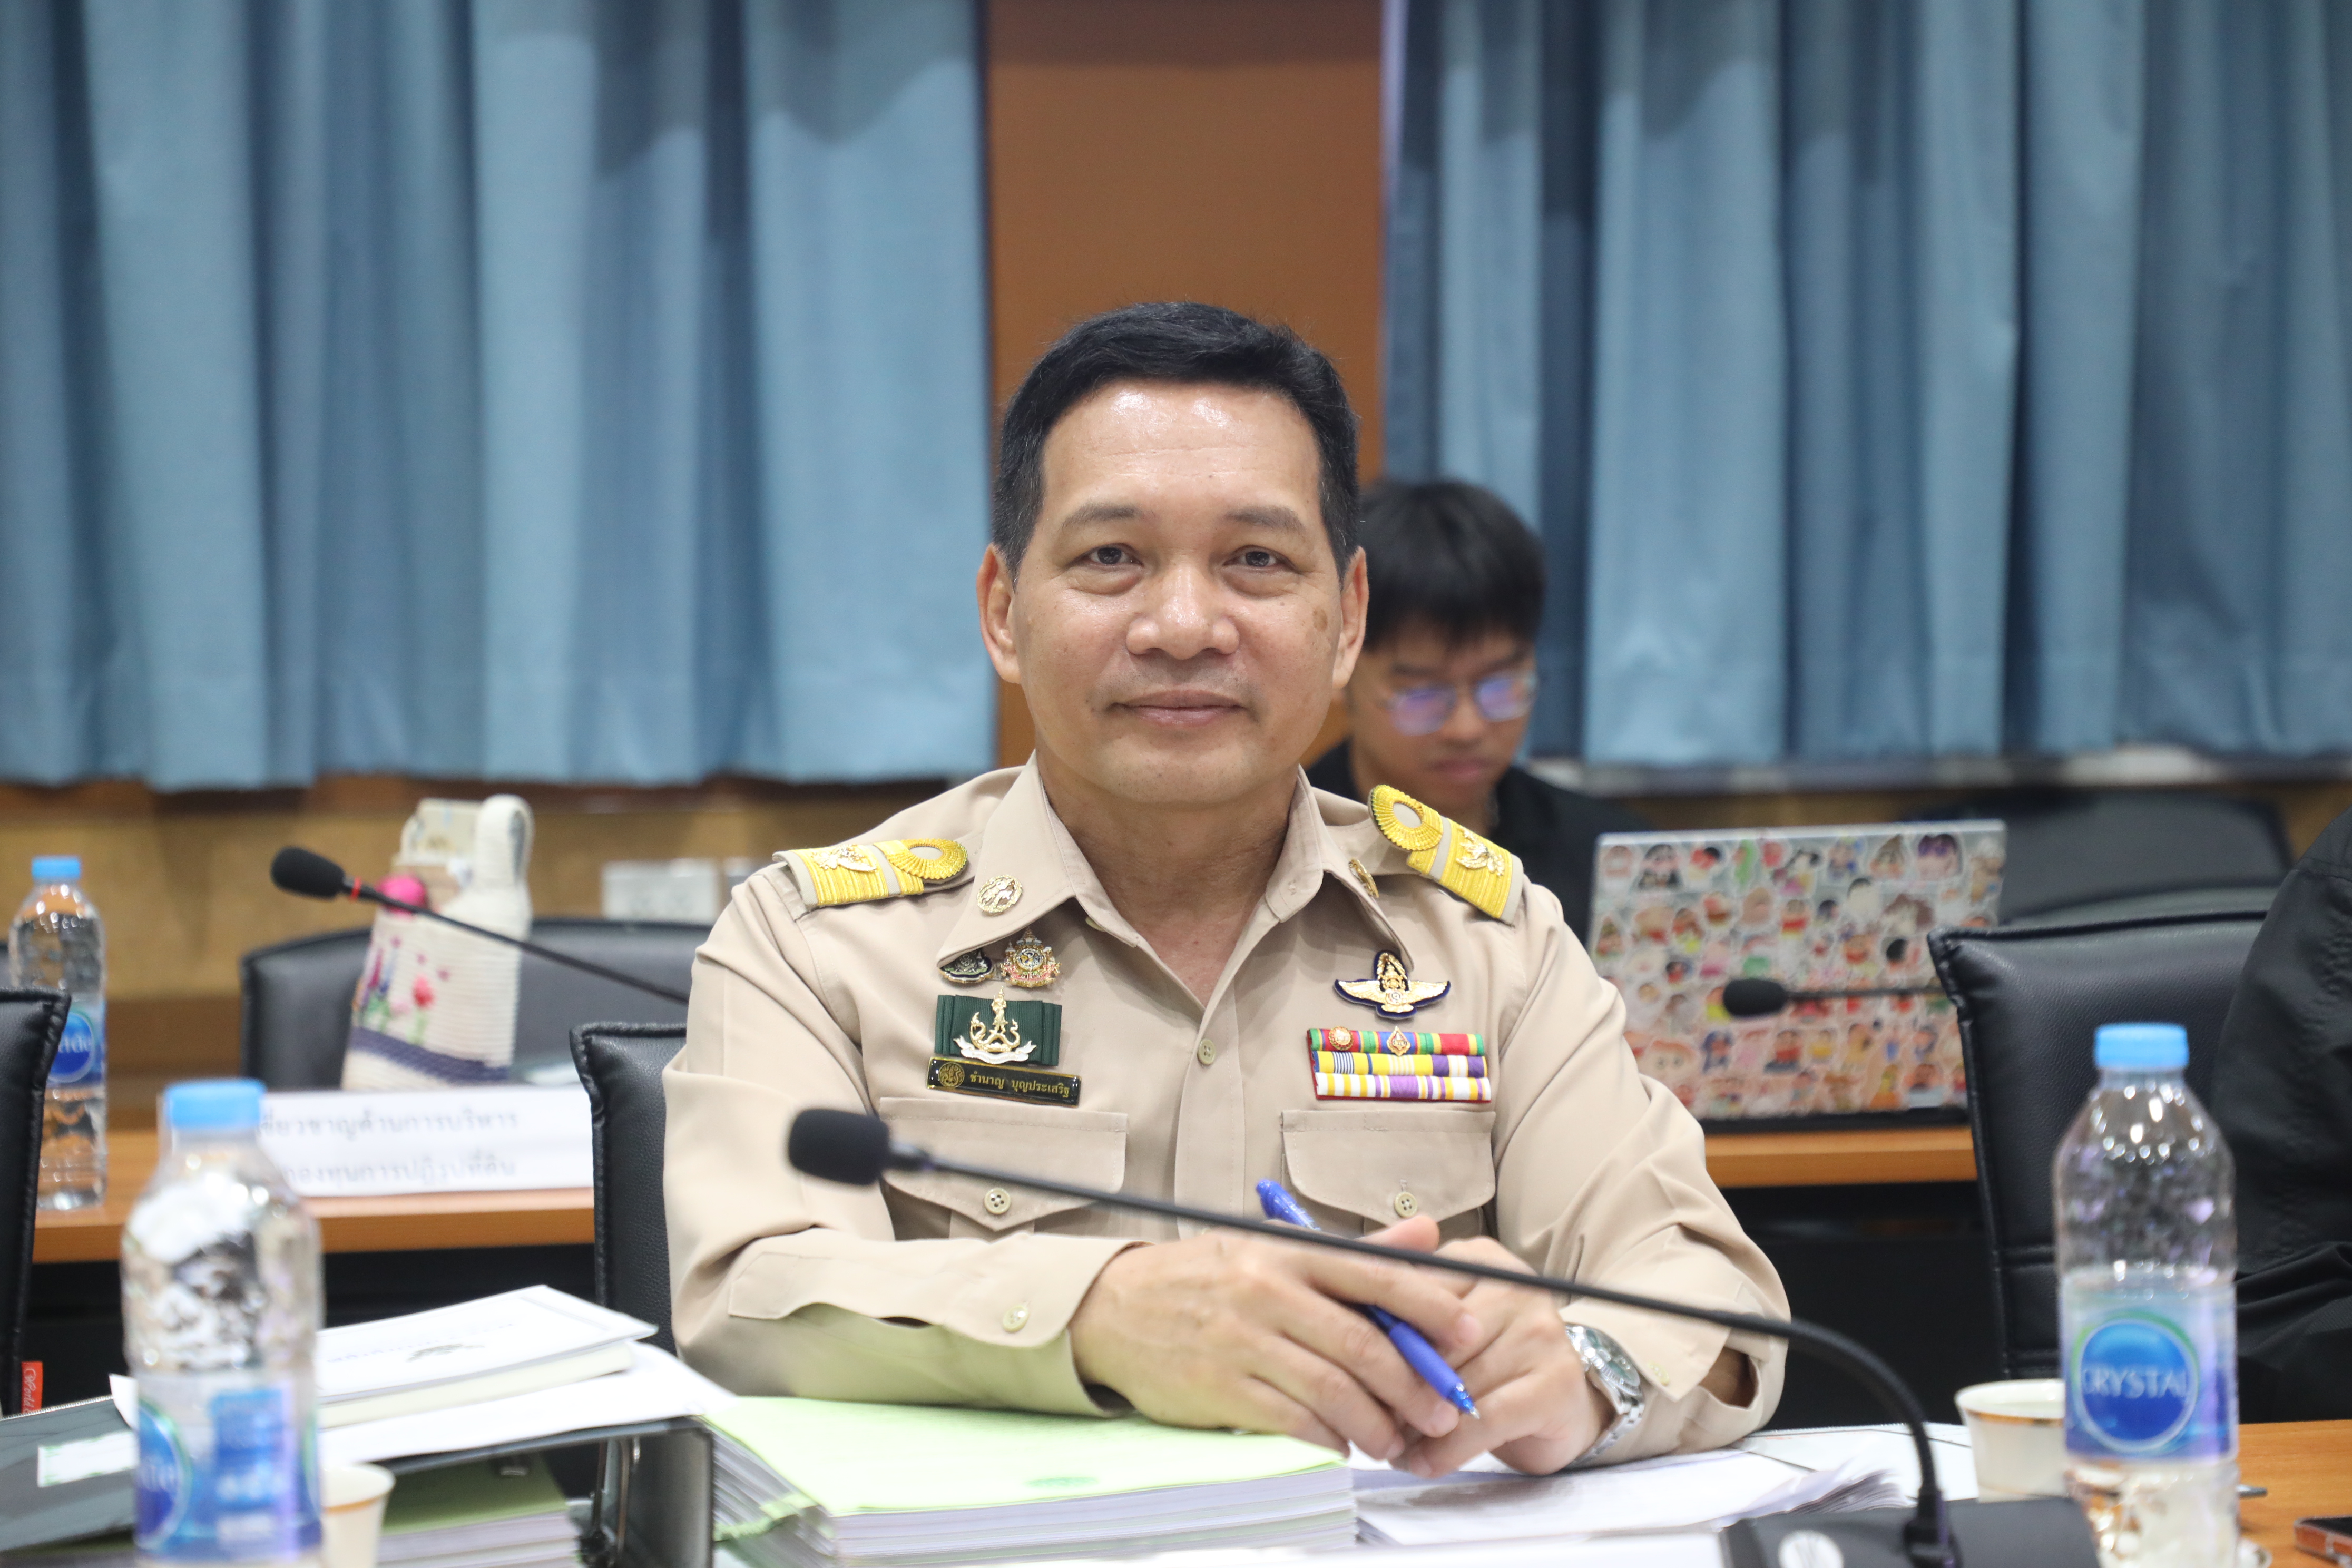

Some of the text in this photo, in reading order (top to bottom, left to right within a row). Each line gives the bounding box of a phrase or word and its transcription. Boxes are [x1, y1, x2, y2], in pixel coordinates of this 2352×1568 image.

[969, 1071, 1070, 1098] ชำนาญ บุญประเสริฐ
